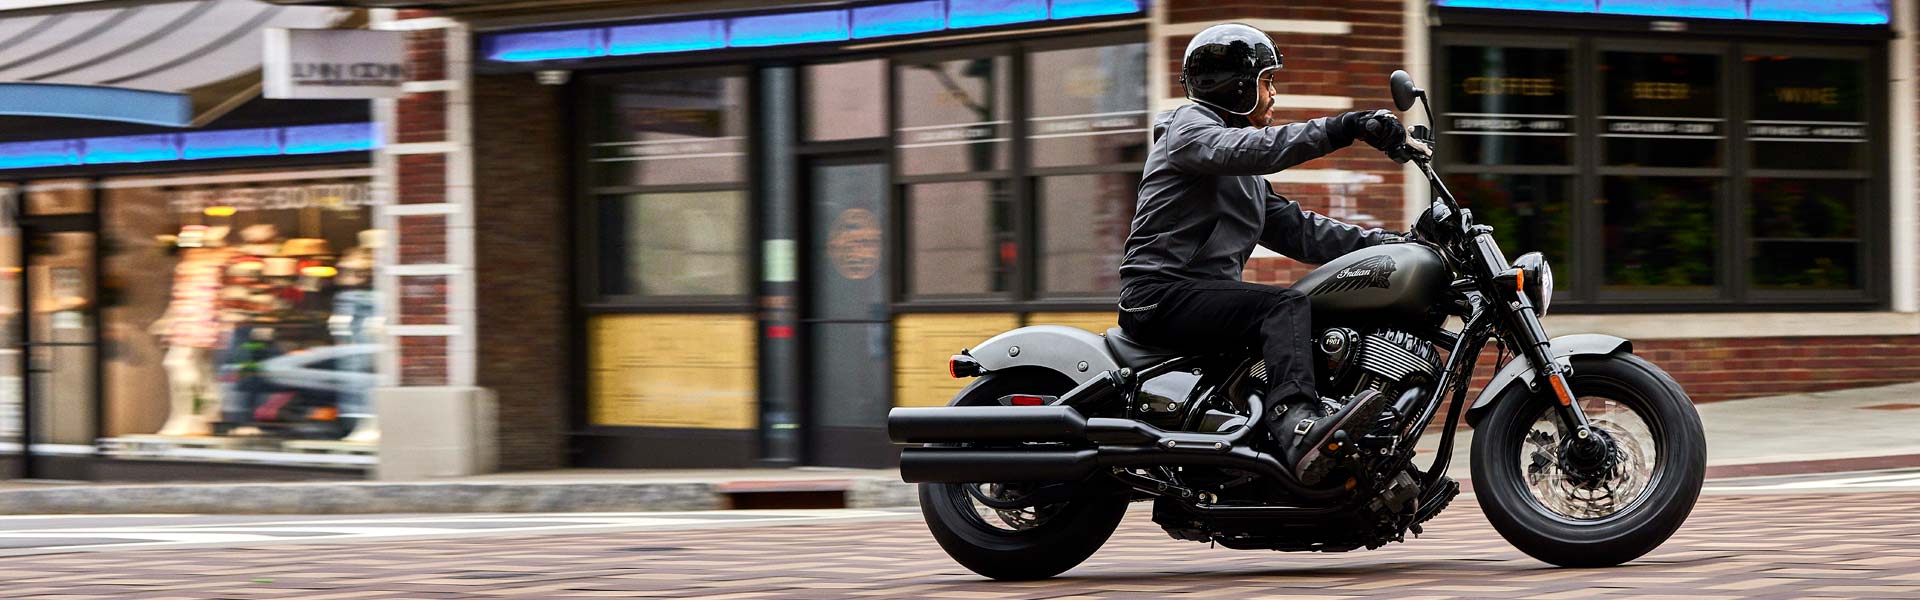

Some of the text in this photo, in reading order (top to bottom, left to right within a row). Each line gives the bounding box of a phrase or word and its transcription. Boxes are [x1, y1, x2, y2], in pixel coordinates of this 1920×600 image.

[1463, 76, 1553, 96] COFFEE
[1776, 87, 1839, 105] WINE
[1336, 267, 1371, 279] Indian
